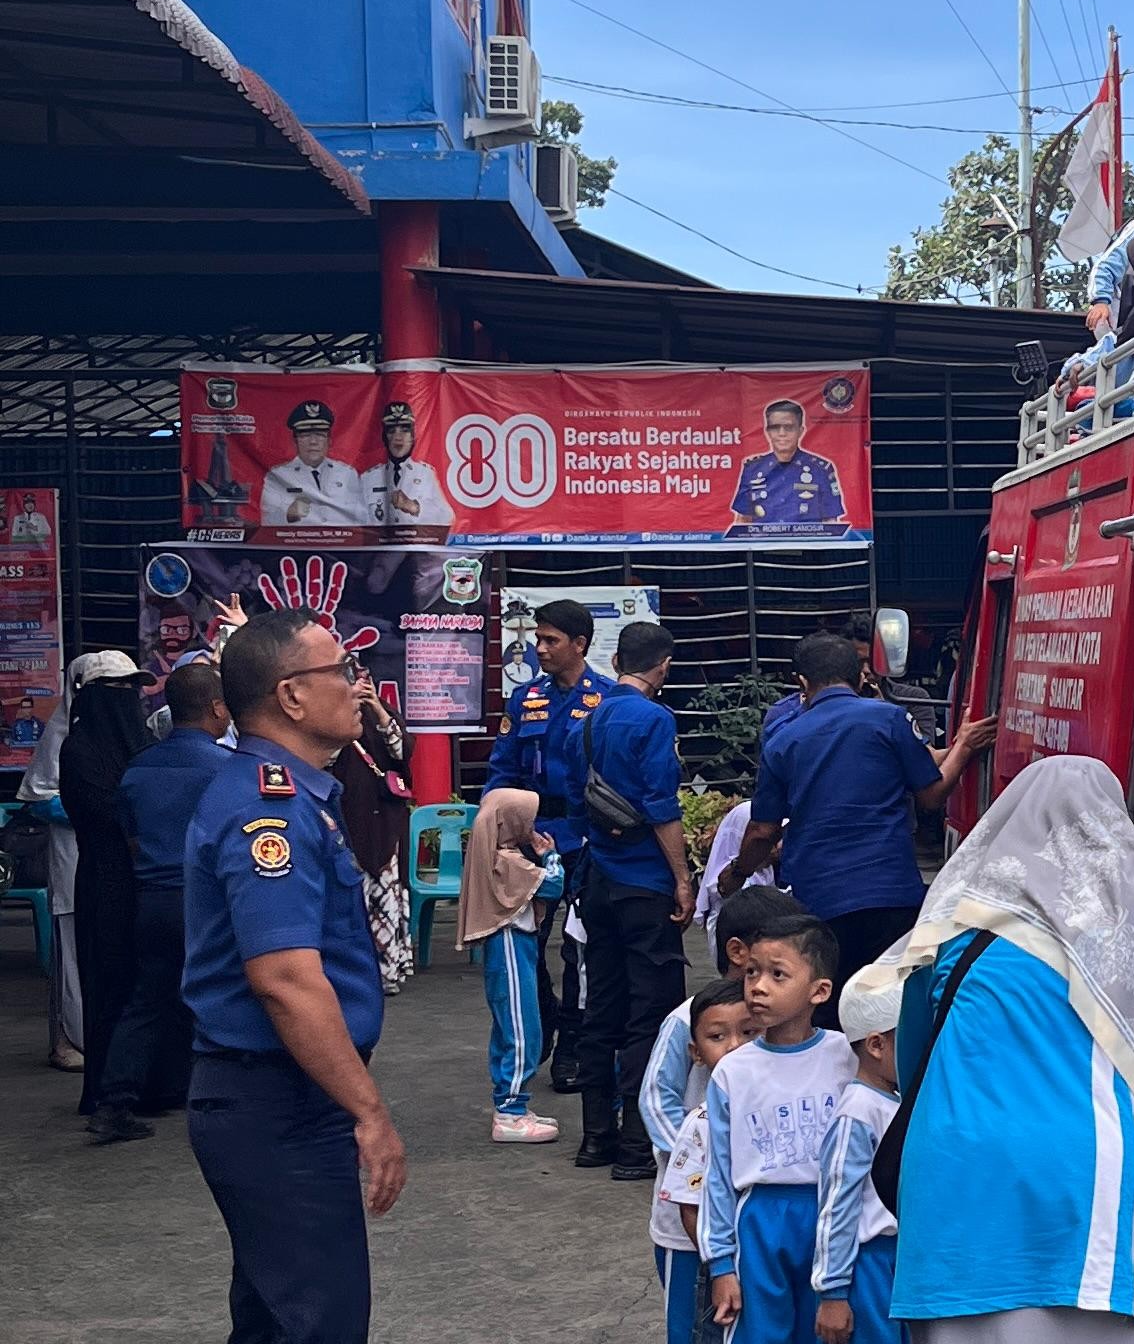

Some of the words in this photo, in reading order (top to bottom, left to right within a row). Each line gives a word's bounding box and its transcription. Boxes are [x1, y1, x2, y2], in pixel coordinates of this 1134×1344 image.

[656, 409, 701, 418] INDONESIA
[564, 427, 641, 446] Bersatu
[646, 426, 742, 446] Berdaulat
[446, 413, 557, 509] 80
[564, 451, 632, 474] Rakyat
[637, 450, 732, 474] Sejahtera
[564, 475, 660, 495] Indonesia
[666, 474, 711, 498] Maju
[651, 533, 682, 542] Damkar
[684, 532, 712, 542] siantar
[1062, 584, 1115, 620] KEBAKARAN
[399, 613, 440, 630] BAHAYA
[440, 613, 485, 630] NARKOBA
[1024, 632, 1077, 664] PENYELAMATAN
[1075, 632, 1102, 665] KOTA
[1049, 677, 1085, 711] SIANTAR
